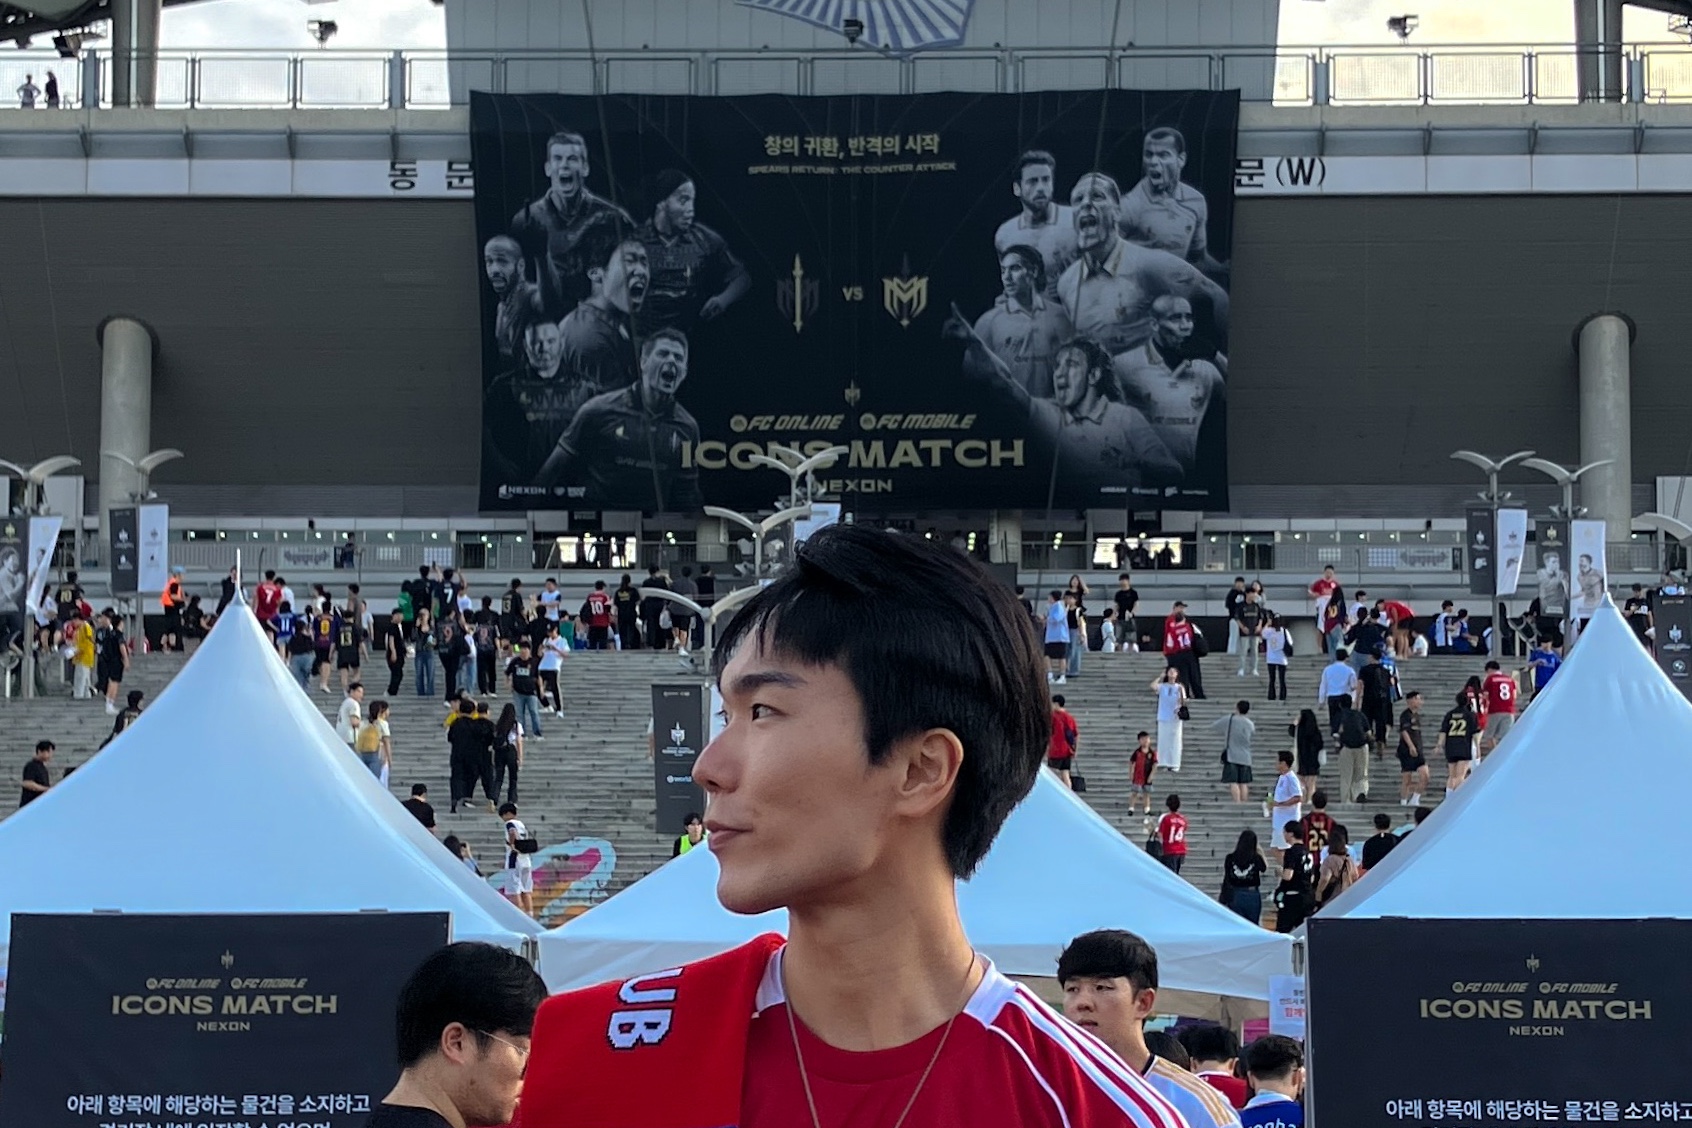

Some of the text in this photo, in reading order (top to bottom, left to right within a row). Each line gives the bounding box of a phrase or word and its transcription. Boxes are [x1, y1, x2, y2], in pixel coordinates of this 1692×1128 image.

[765, 134, 939, 159] 창의 귀환, 반격의 시작
[1276, 157, 1326, 187] (W)
[843, 287, 863, 300] VS
[748, 414, 976, 431] FC ONLINE FC MOBILE
[681, 440, 835, 470] ICONS
[848, 439, 1025, 468] MATCH
[811, 480, 892, 493] NEXON
[265, 588, 273, 602] 7
[590, 601, 603, 615] 10
[1499, 682, 1511, 700] 8
[1448, 719, 1467, 737] 22
[112, 995, 337, 1015] ICONS MATCH
[607, 967, 684, 1049] UB
[1420, 998, 1652, 1019] ICONS MATCH
[197, 1021, 250, 1031] NEXON
[1509, 1026, 1564, 1036] NEXON
[67, 1094, 371, 1115] 아래 항목에 해당하는 물건을 소지하고
[1386, 1099, 1692, 1121] 아래 항목에 해당하는 물건을 소지하고
